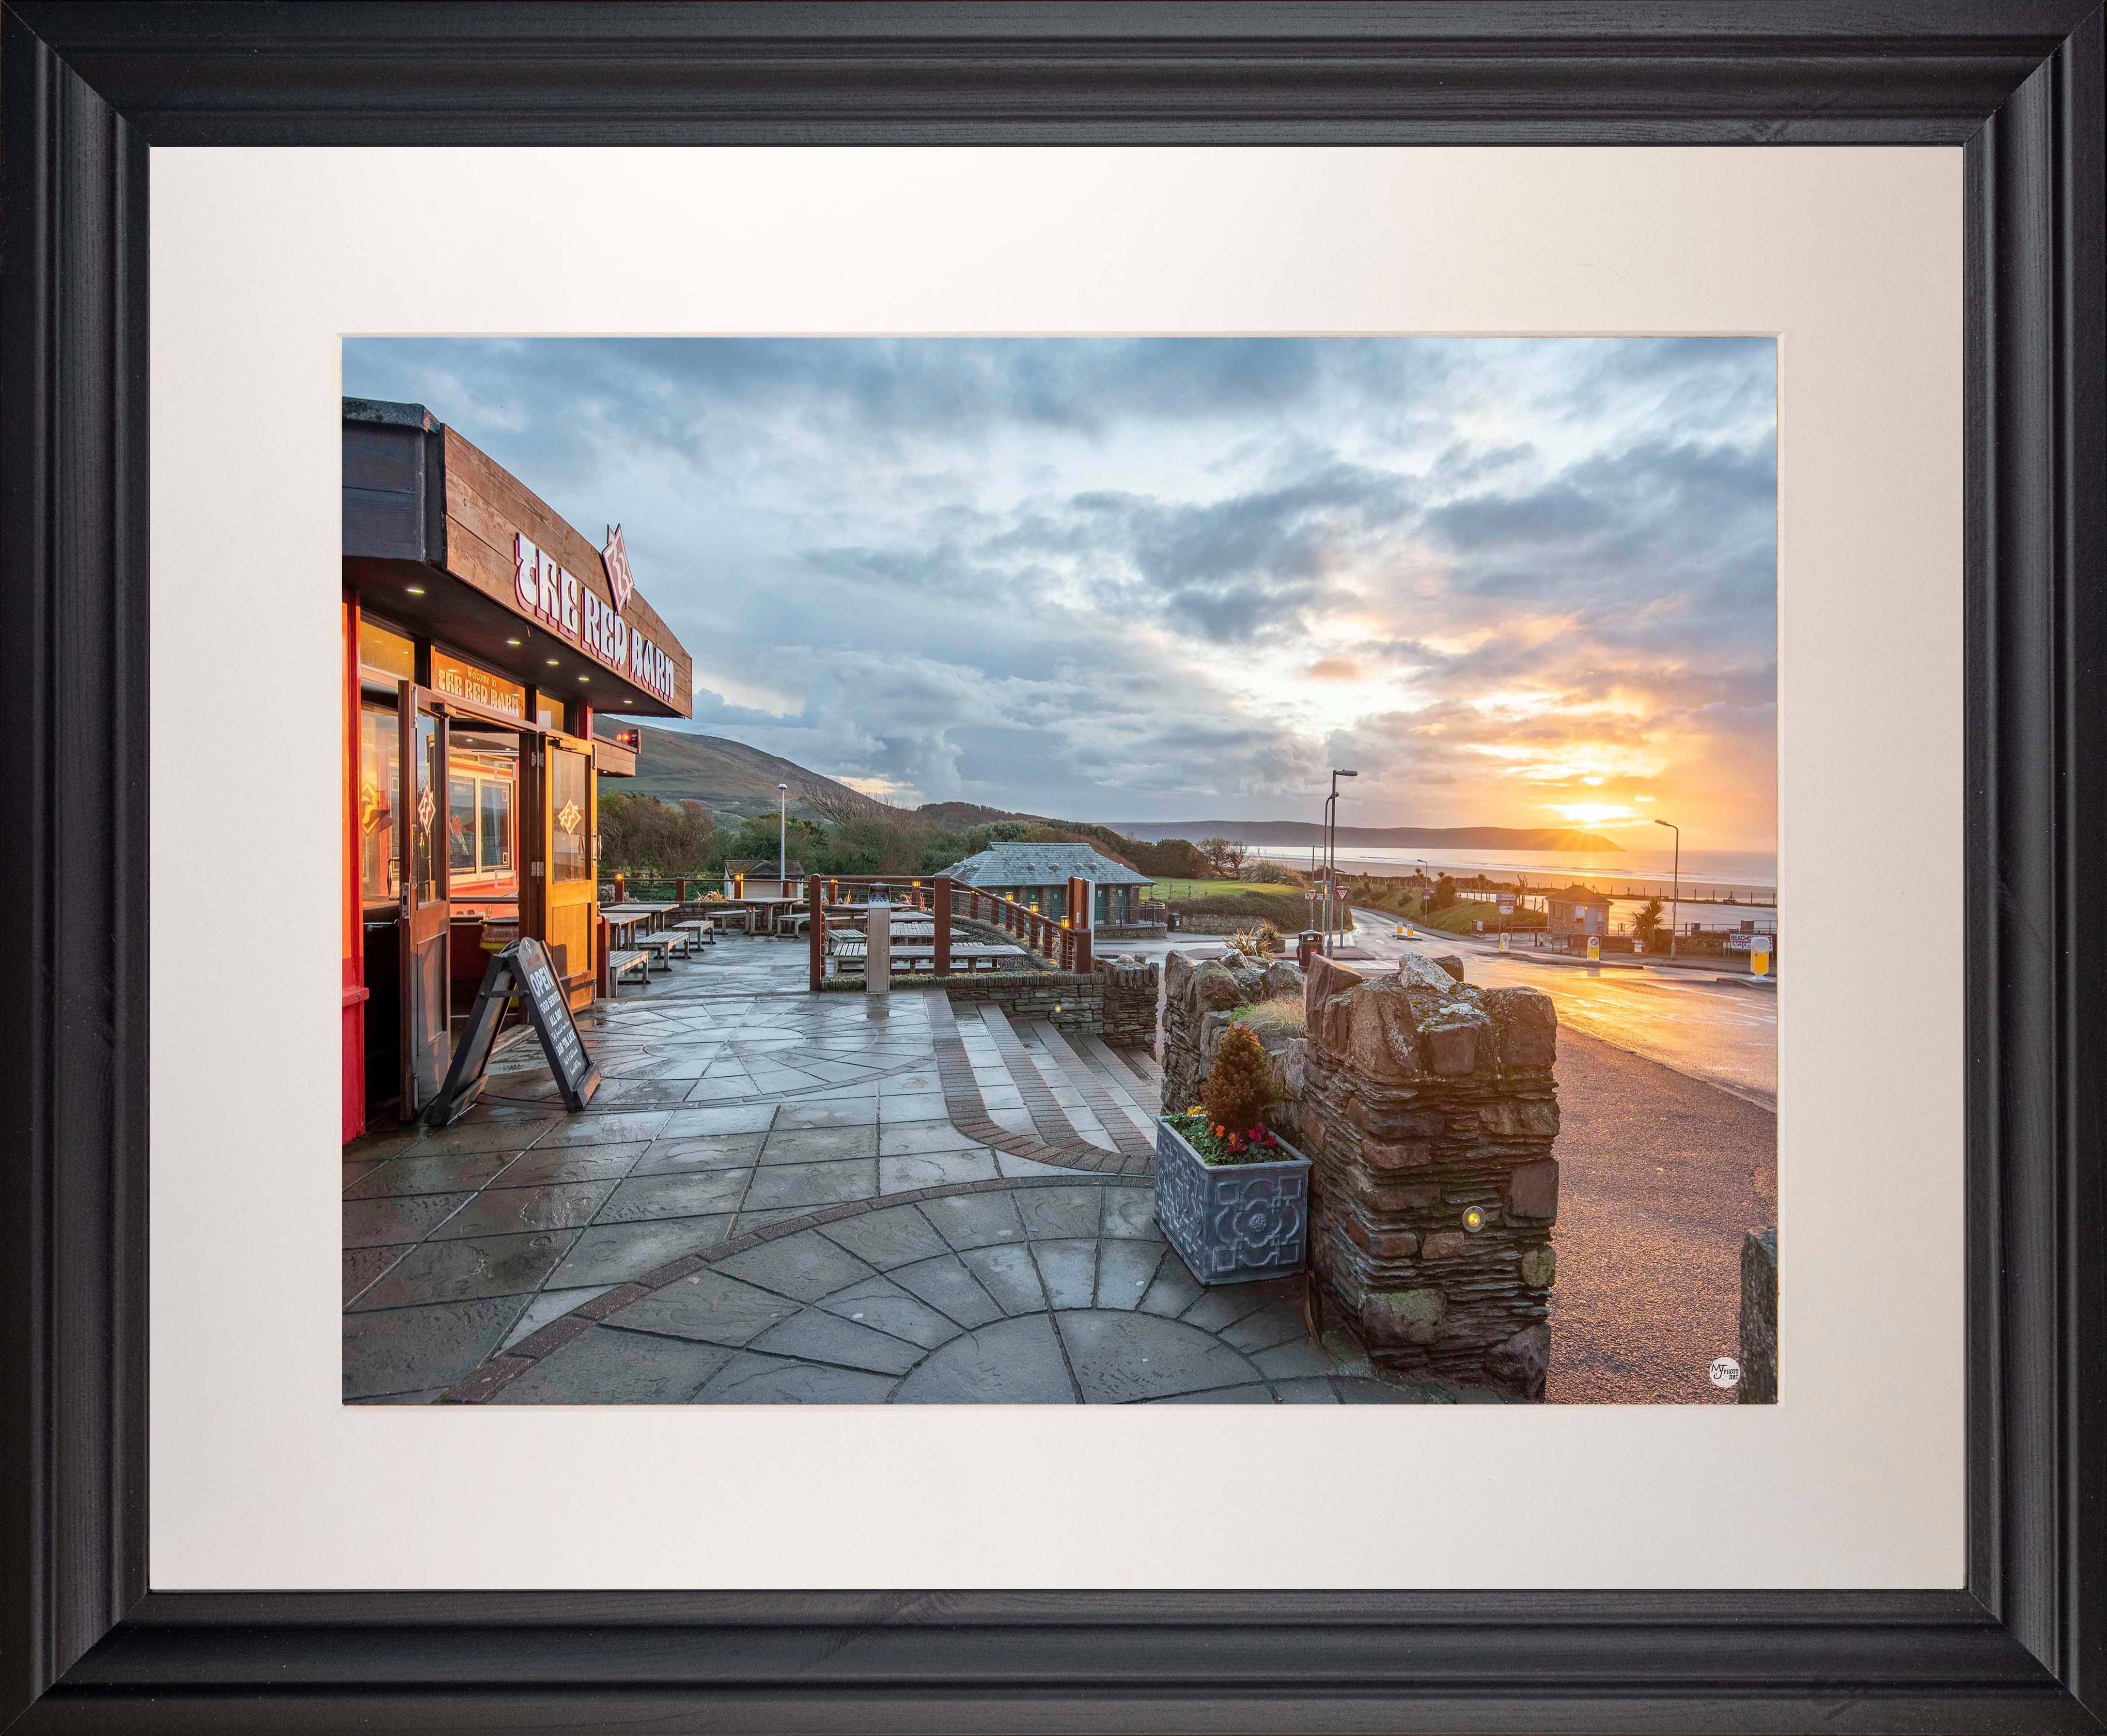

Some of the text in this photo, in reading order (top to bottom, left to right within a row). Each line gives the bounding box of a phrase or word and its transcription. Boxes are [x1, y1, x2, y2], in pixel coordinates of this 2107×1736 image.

[514, 533, 674, 705] THE RED BARN
[467, 666, 497, 687] Welcome to
[438, 668, 520, 718] THE RED BARN
[530, 965, 554, 997] OPEN
[547, 990, 561, 1008] SERVED
[549, 1007, 563, 1027] ALL DAY
[567, 1028, 576, 1044] LATE
